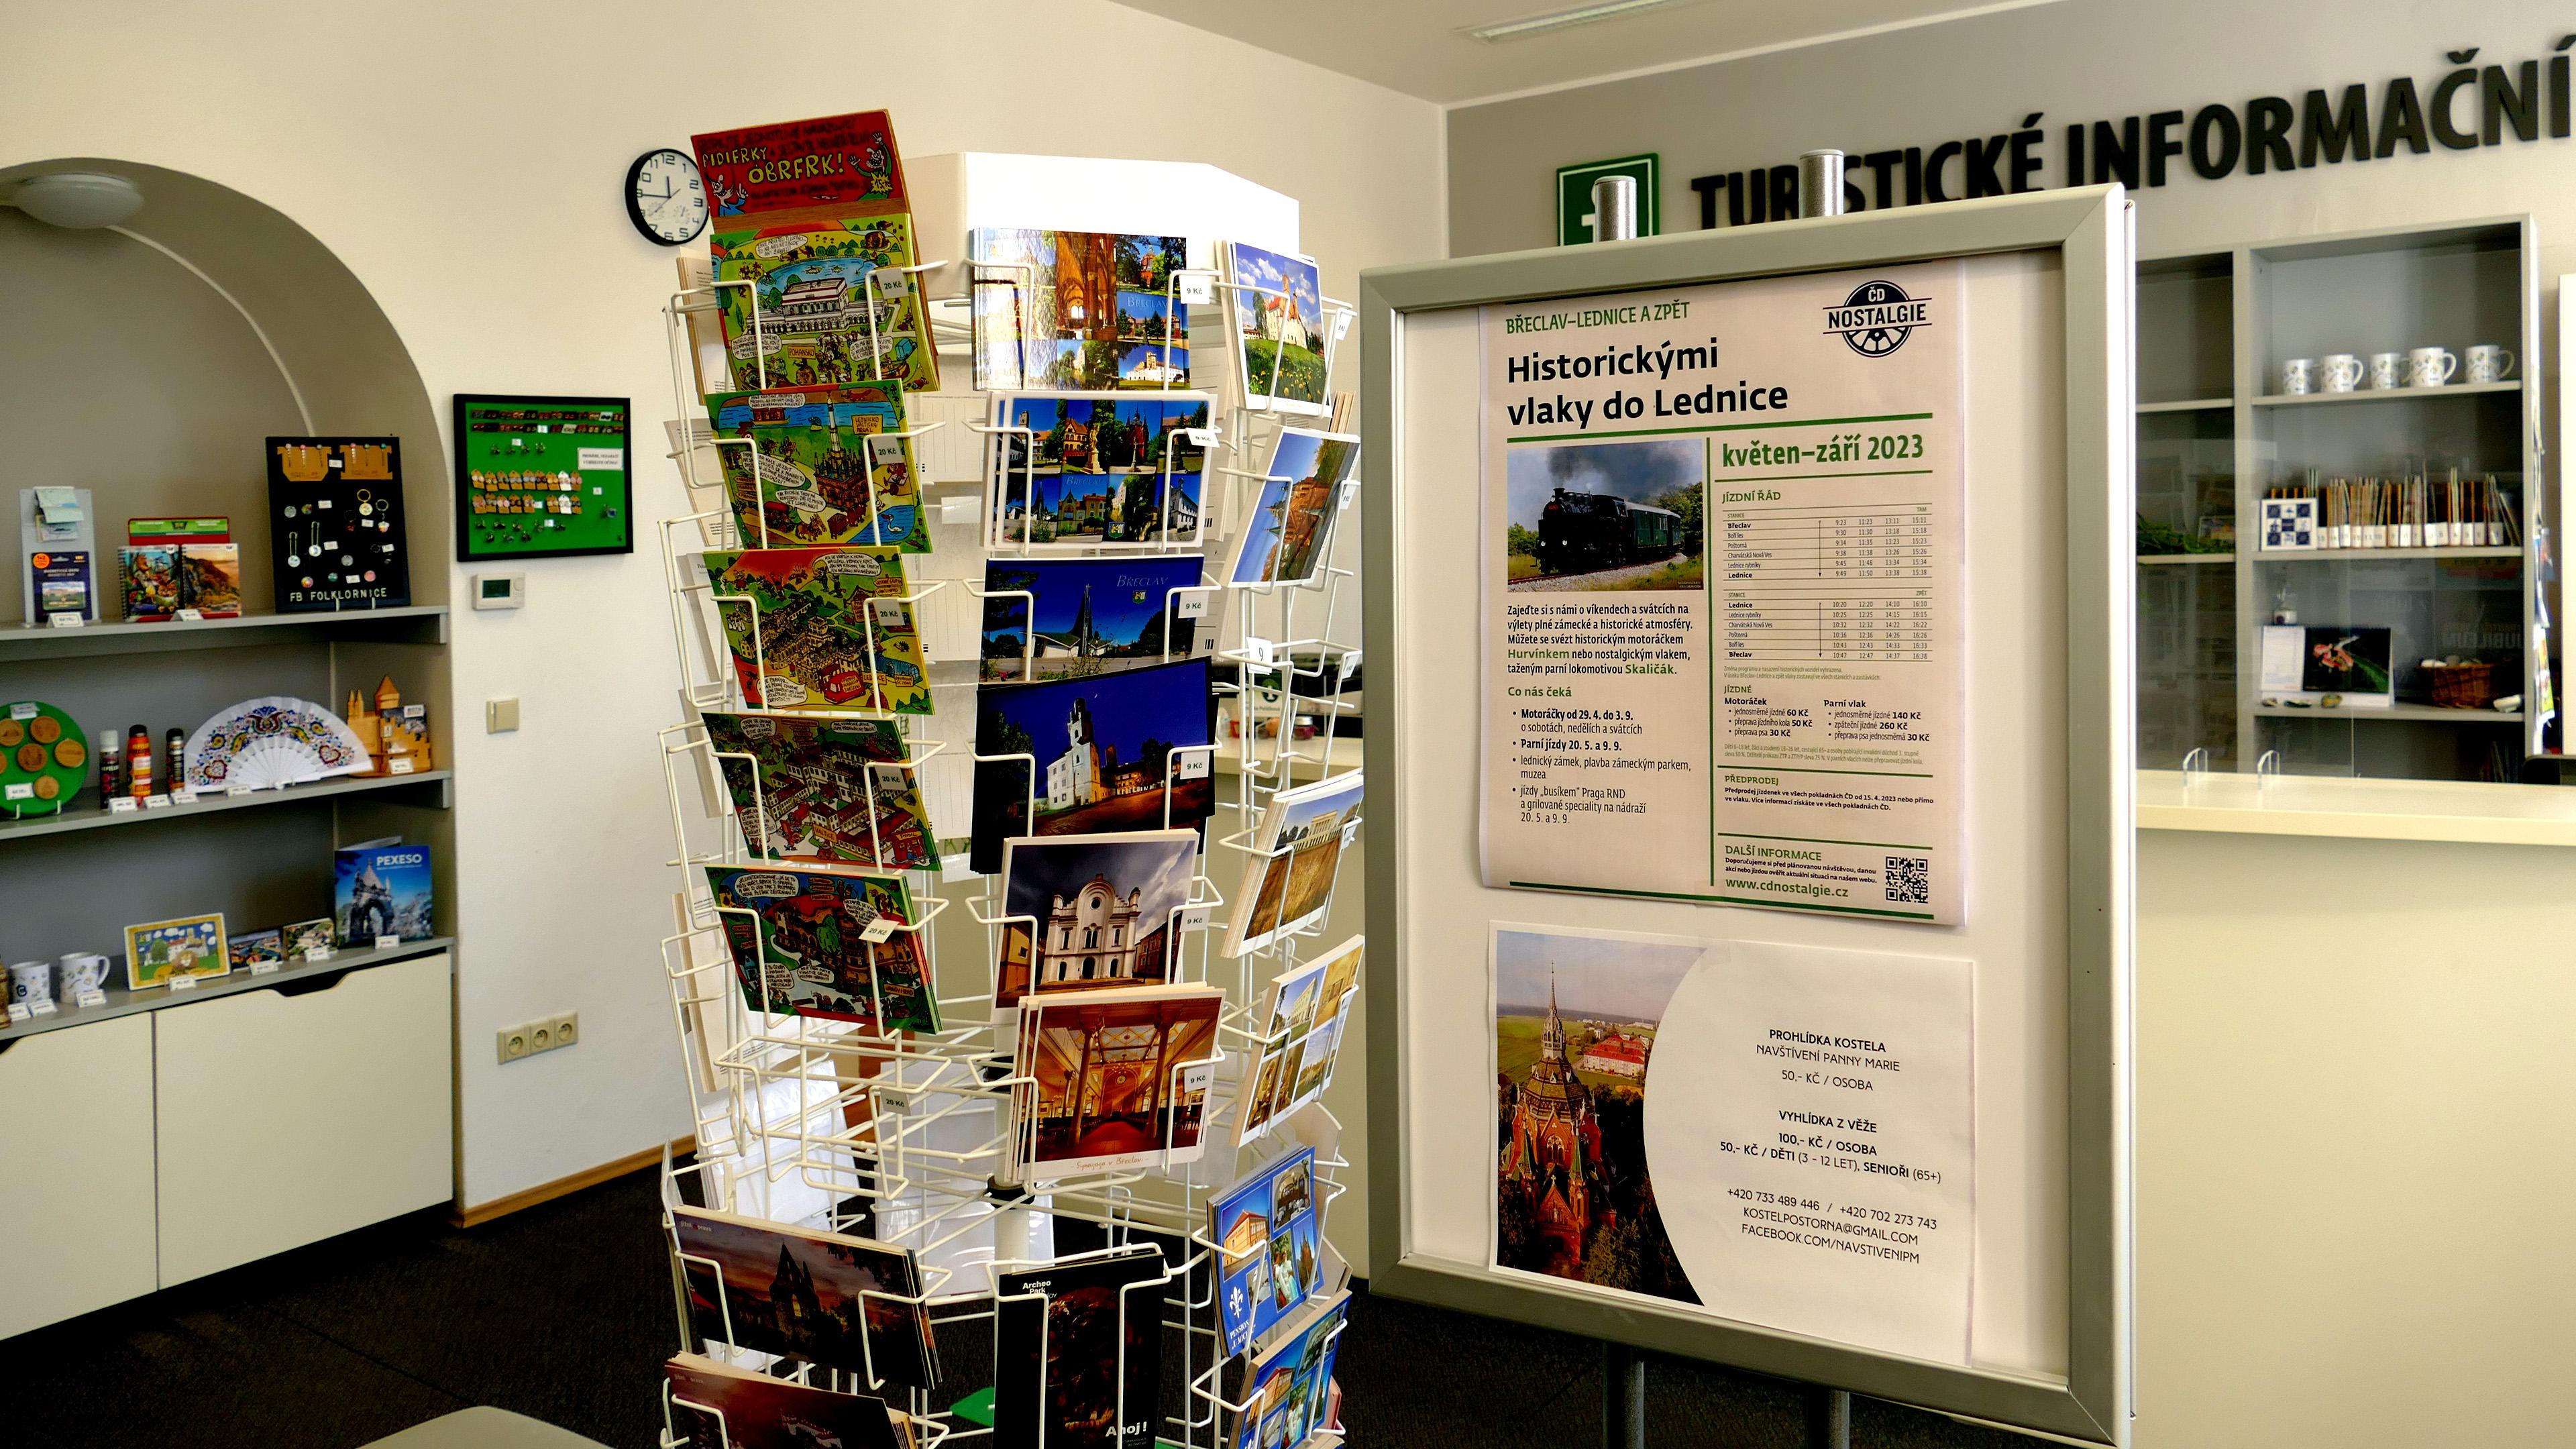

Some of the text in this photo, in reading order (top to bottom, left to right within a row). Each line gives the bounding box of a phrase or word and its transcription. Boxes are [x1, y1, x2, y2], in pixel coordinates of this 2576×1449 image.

[1691, 35, 2576, 229] TURSTICKÉ INFORMAČNÍ
[661, 154, 675, 165] 12
[690, 179, 698, 189] 2
[694, 198, 703, 207] 3
[1869, 286, 1885, 301] ČD
[1641, 306, 1650, 322] A
[1654, 302, 1690, 320] ZPĚT
[1827, 301, 1927, 329] NOSTALGIE
[1508, 337, 1718, 383] Historickými
[1507, 380, 1788, 429] vlaky do Lednice
[1868, 435, 1923, 460] 2023
[1723, 490, 1781, 503] JÍZDNÍ ŘÁD
[290, 588, 387, 602] FB FOLKLORNICE
[1508, 605, 1538, 616] Zajeďte
[1541, 605, 1548, 614] si
[1556, 605, 1576, 614] námi
[1587, 604, 1629, 614] víkendech
[1640, 604, 1675, 614] svátcích
[1508, 619, 1532, 632] výlety
[1535, 619, 1552, 631] plné
[1554, 619, 1591, 629] zámecké
[1601, 619, 1643, 629] historické
[1646, 619, 1693, 631] atmosféry.
[1508, 634, 1538, 644] Můžete
[1551, 634, 1572, 644] svézt
[1575, 634, 1625, 646] historickým
[1627, 633, 1683, 644] motoráčkem
[1259, 647, 1263, 661] 9
[1508, 649, 1690, 661] Hurvínkem nebo nostalgickým vlakem,
[1508, 664, 1677, 676] taženým parní lokomotivou Skaličák.
[1508, 686, 1572, 696] Co nás čeká
[1724, 686, 1752, 694] JÍZDNÉ
[1725, 698, 1766, 706] Motoráček
[1824, 700, 1846, 708] Parní
[1521, 709, 1565, 721] Motoráčky
[1567, 710, 1576, 719] od
[1578, 710, 1591, 720] 29.
[1603, 710, 1614, 720] do
[1911, 712, 1921, 720] Kč
[1521, 739, 1544, 749] Parní
[1545, 739, 1566, 751] jízdy
[1568, 741, 1582, 750] 20.
[1521, 755, 1691, 771] lednický zámek, plavba zámeckým parkem,
[1521, 771, 1546, 779] muzea
[1725, 775, 1779, 786] PŘEDPRODEJ
[1520, 785, 1538, 797] jízdy
[1582, 788, 1605, 800] Praga
[1607, 790, 1625, 798] RND
[377, 854, 422, 866] PEXESO
[1725, 845, 1821, 861] DALŠÍ INFORMACE
[1726, 879, 1849, 897] www.cdnostalgie.cz
[1770, 1030, 1886, 1052] PROHLÍDKA KOSTELA
[1756, 1044, 1900, 1071] NAVŠTÍVENÍ PANNY MARIE
[1806, 1072, 1820, 1084] KČ
[1833, 1077, 1873, 1091] OSOBA
[1779, 1110, 1877, 1132] VYHLÍDKA Z VĚŽE
[1809, 1136, 1823, 1148] KČ
[1836, 1141, 1877, 1155] OSOBA
[1744, 1144, 1758, 1156] KČ
[1771, 1148, 1795, 1161] DĚTI
[1799, 1153, 1809, 1164] (3
[1820, 1156, 1831, 1166] 12
[1864, 1162, 1909, 1177] SENIOŘI
[1913, 1169, 1941, 1184] (65+)
[1727, 1189, 1937, 1230] +420 733 489 446 +420 702 273 743
[1743, 1208, 1918, 1245] KOSTELPOSTORNA@GMAIL.COM
[1742, 1224, 1919, 1264] FACEBOOK.COM/NAVSTIVENIPM
[1022, 1281, 1051, 1289] Archeo
